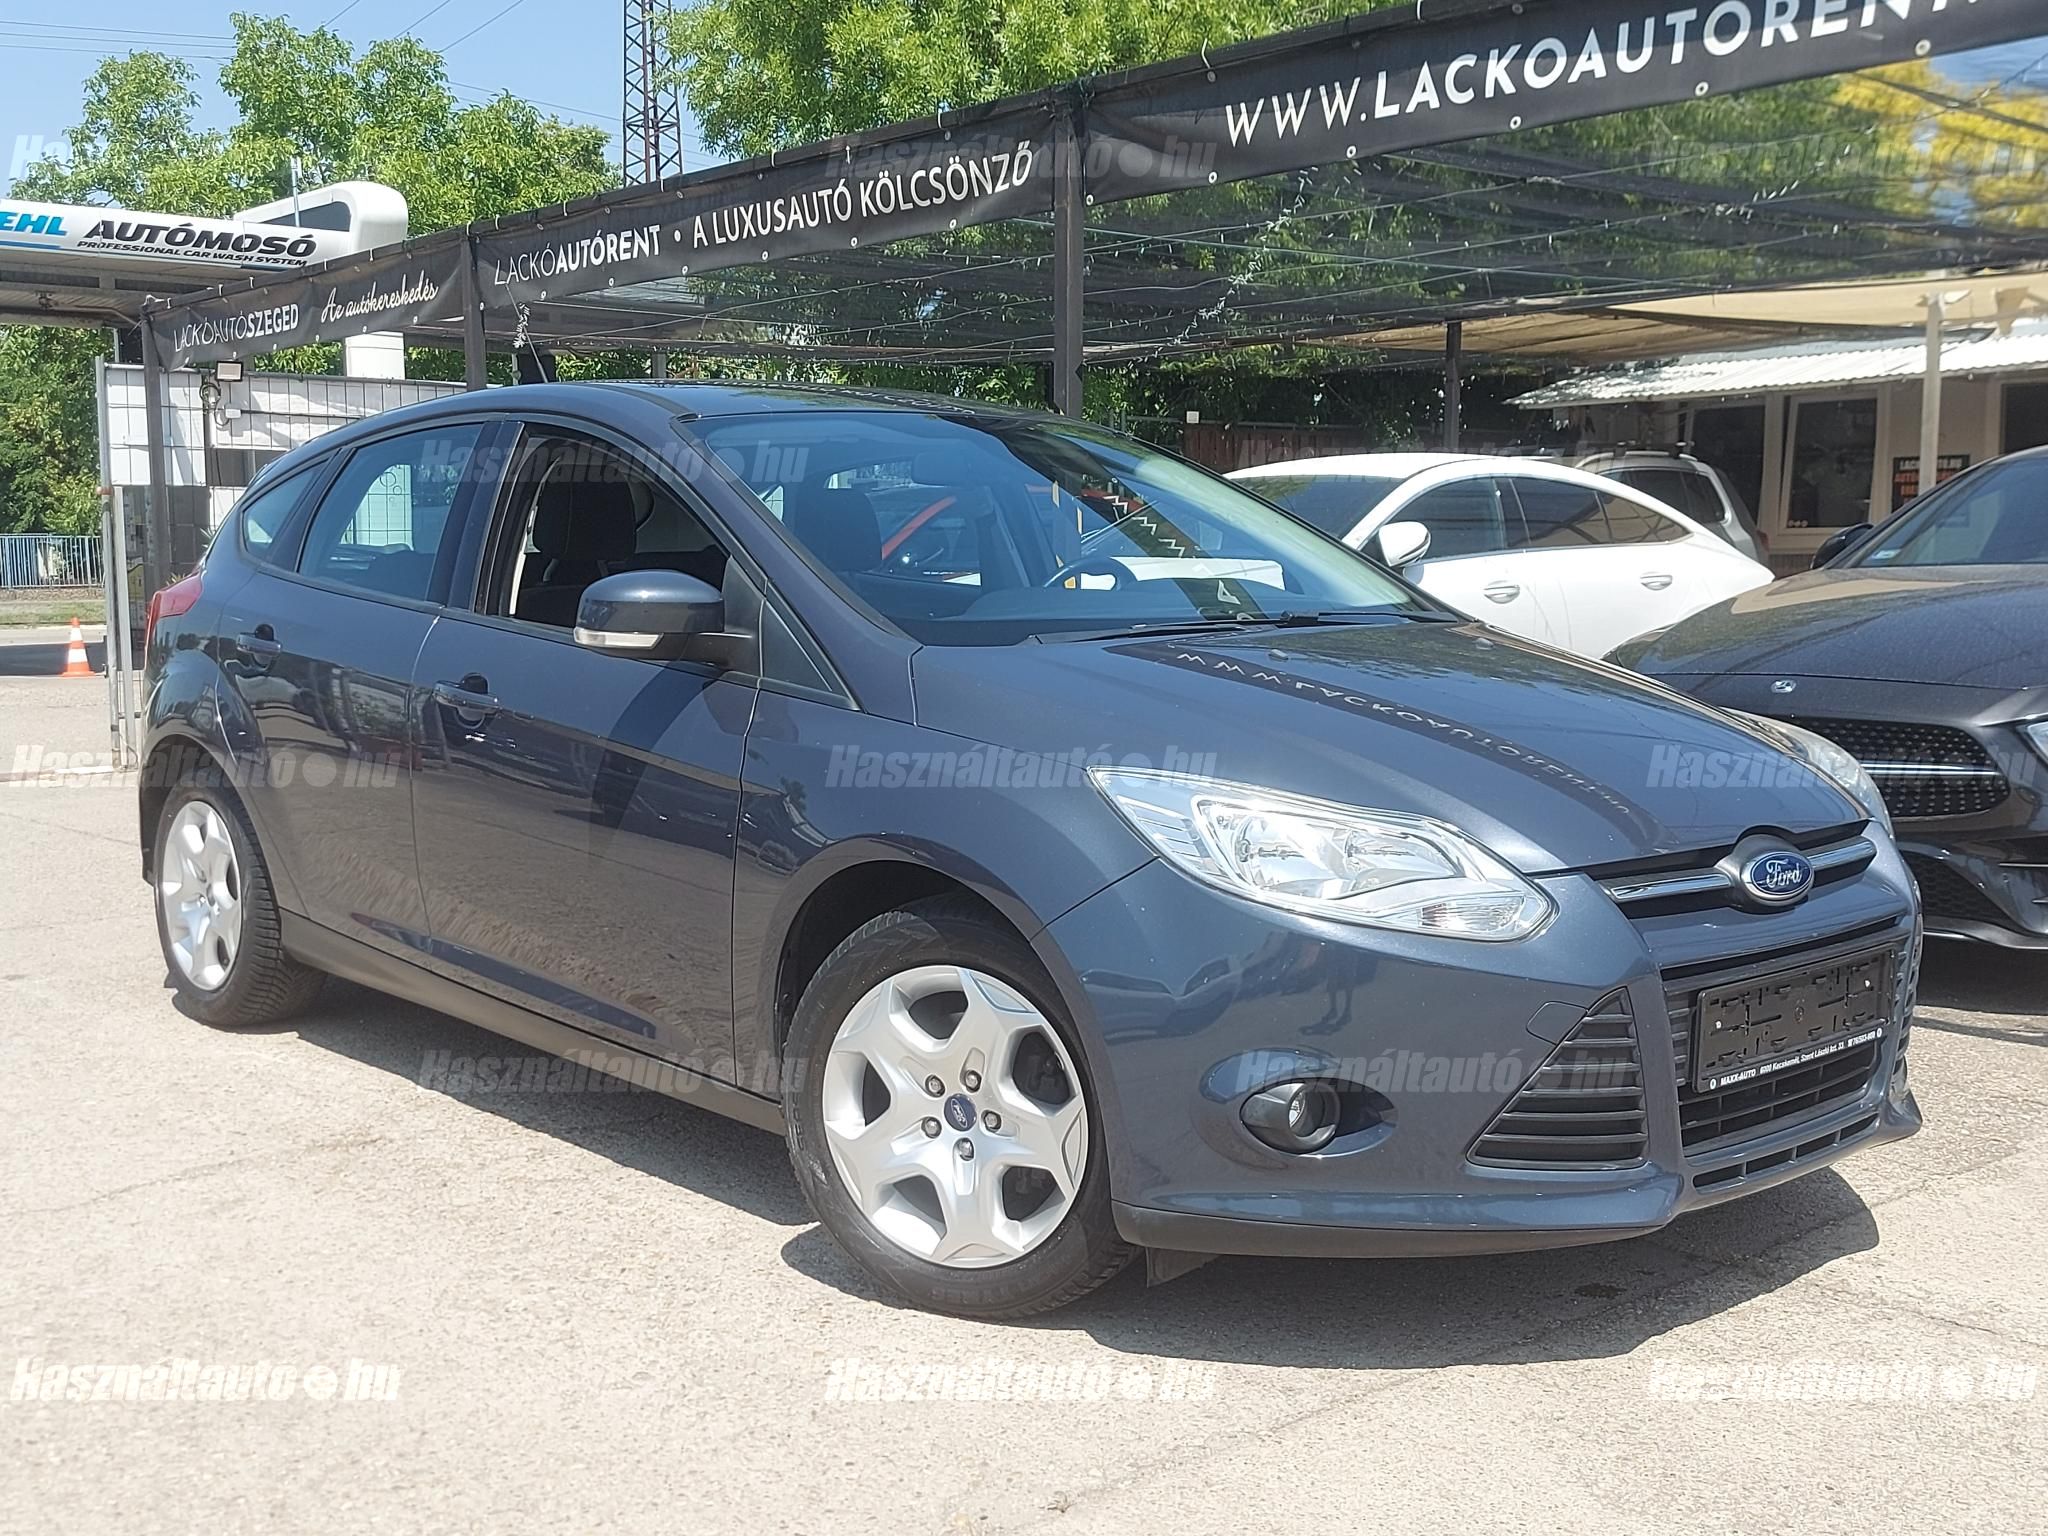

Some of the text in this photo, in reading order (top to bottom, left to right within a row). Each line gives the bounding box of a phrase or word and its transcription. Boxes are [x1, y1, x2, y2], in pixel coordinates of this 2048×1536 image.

[494, 140, 1033, 286] LACKÓAUTÓRENT A LUXUSAUTÓ KÖLCSÖNZŐ
[77, 240, 308, 267] PROFESSIONAL CAR WASH SYSTEM
[84, 219, 317, 258] AUTÓMOSÓ
[173, 303, 299, 353] LACKÓAUTÓSZEGED
[345, 269, 439, 318] autókereskedés
[1764, 858, 1803, 888] Ford
